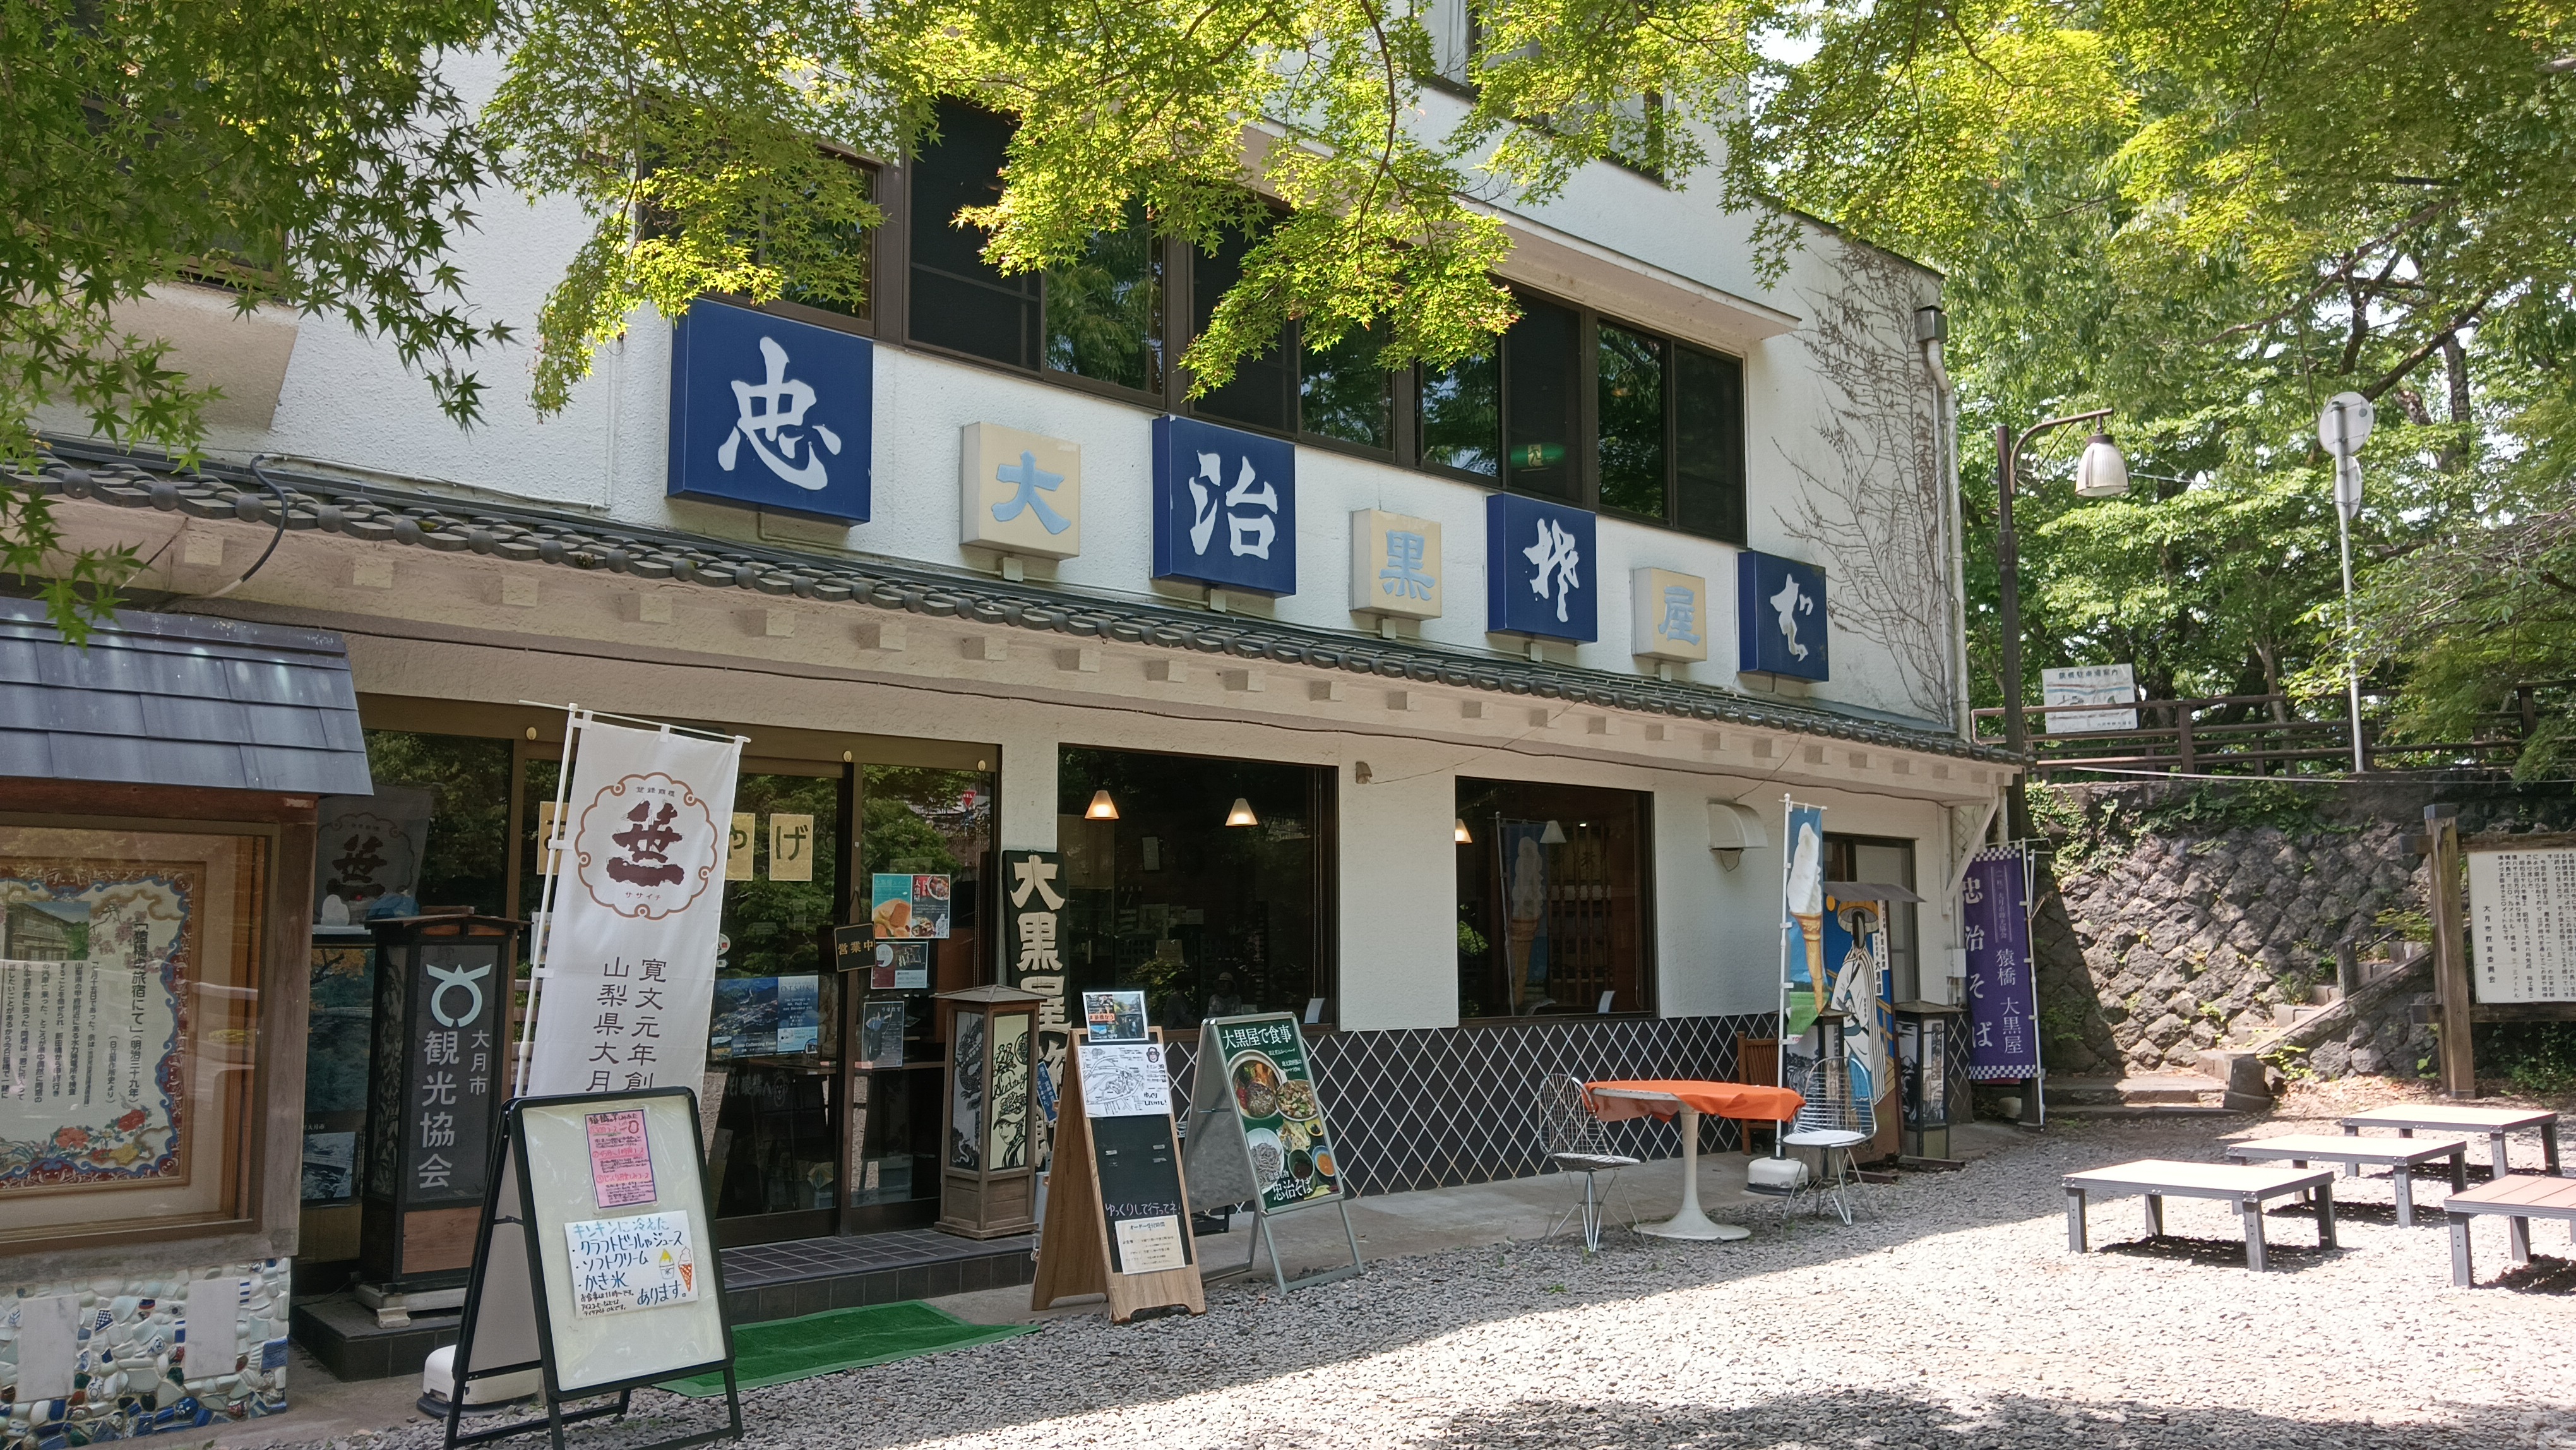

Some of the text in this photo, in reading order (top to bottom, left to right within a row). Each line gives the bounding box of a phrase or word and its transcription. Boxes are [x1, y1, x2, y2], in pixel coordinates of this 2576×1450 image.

[718, 337, 842, 491] 忠
[1189, 449, 1277, 560] 治
[991, 450, 1701, 645] 大 黒 屋
[837, 938, 874, 956] 営業中
[2483, 905, 2496, 984] 大月市教育委員会
[780, 984, 814, 993] OTSUKI
[1996, 949, 2024, 1054] 猿橋 大黒屋
[586, 956, 630, 1093] 山梨県大月
[1222, 1024, 1292, 1050] 大黒屋で食事
[469, 1029, 490, 1096] 大月市
[417, 1029, 460, 1190] 観光協会
[1272, 1175, 1314, 1201] 忠治そば
[573, 1216, 669, 1239] キンキンに冷えた
[585, 1271, 629, 1293] かき氷
[637, 1280, 687, 1306] あります。
